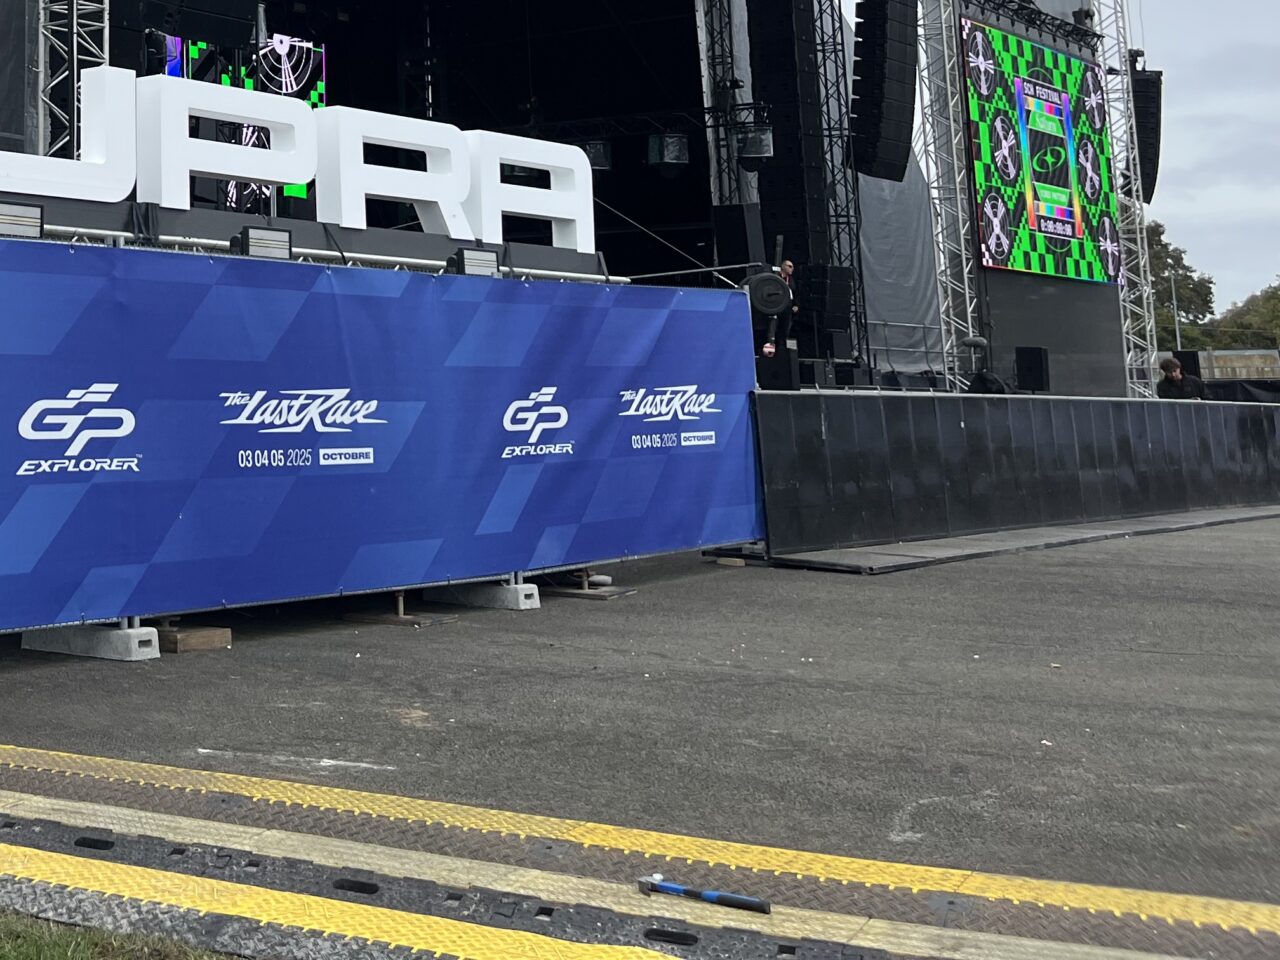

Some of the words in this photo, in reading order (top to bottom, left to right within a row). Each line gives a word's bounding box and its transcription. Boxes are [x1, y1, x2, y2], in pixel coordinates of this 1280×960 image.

[18, 383, 136, 456] GP
[503, 386, 568, 444] GP
[662, 433, 677, 447] 2025
[287, 448, 312, 466] 2025
[322, 450, 371, 462] OCTOBRE
[501, 443, 574, 458] EXPLORER
[16, 457, 140, 475] EXPLORER
